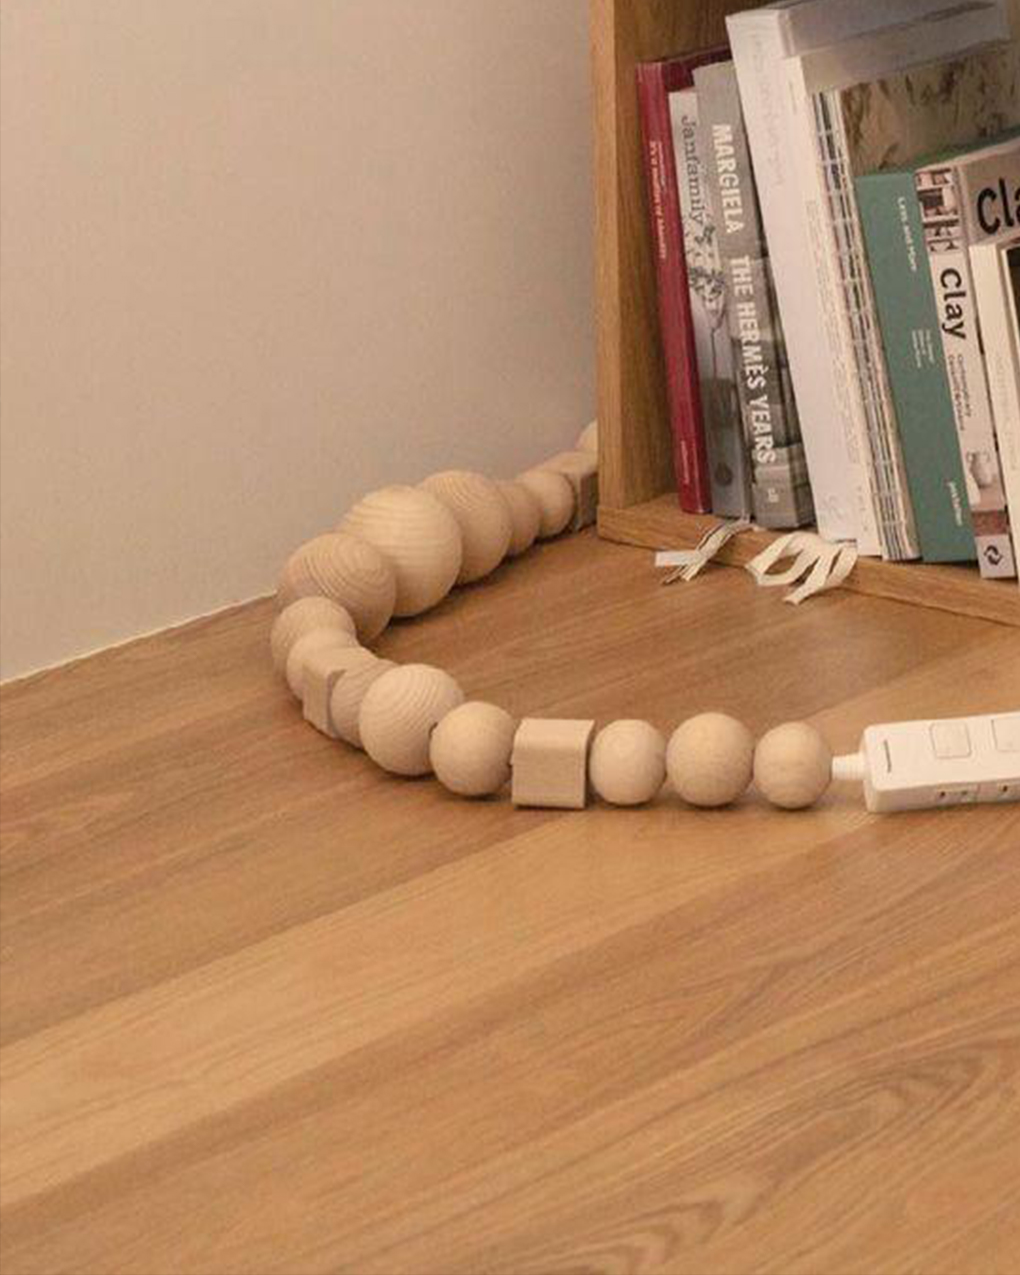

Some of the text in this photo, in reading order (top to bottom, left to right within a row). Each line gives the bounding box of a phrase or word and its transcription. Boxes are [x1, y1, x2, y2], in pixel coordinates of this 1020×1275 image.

[713, 125, 744, 233] MARGIELA
[730, 255, 754, 296] THE
[940, 268, 967, 340] Clay
[737, 302, 768, 389] HERMÈS
[750, 394, 776, 463] YEARS
